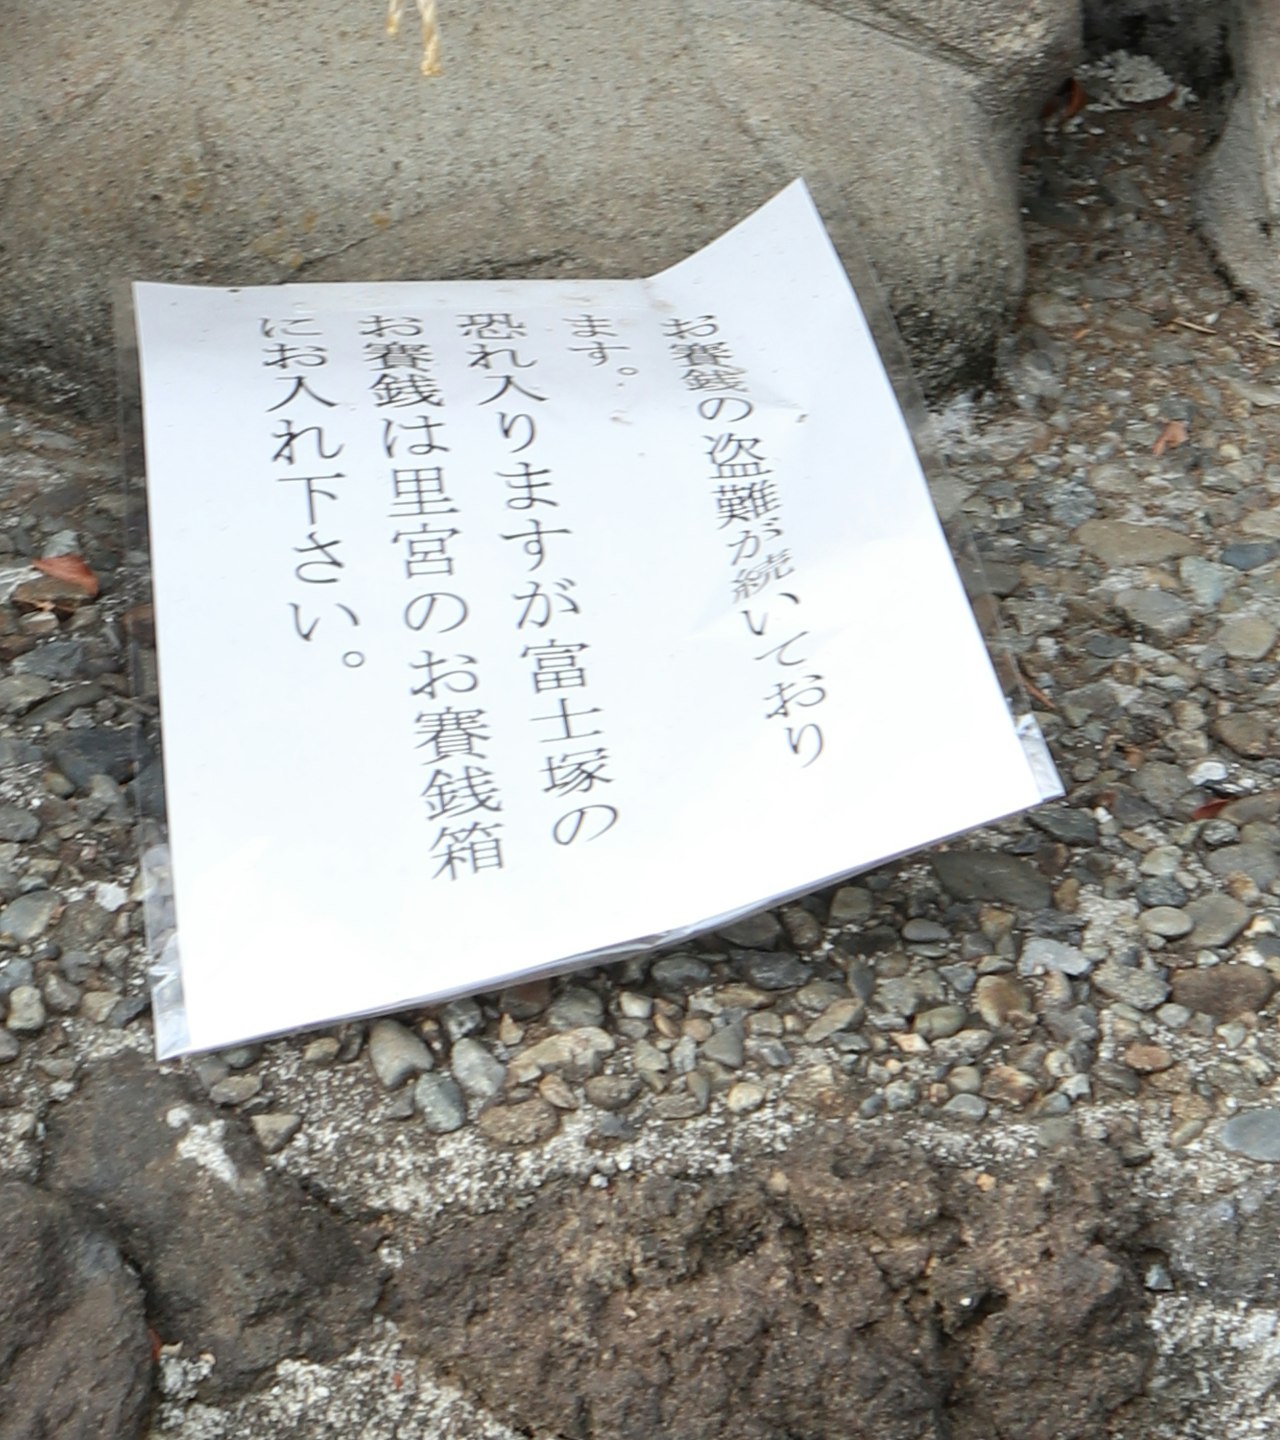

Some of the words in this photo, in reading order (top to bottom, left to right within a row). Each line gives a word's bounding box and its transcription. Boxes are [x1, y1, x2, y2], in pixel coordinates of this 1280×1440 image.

[258, 316, 366, 670] にお入れ下さい。
[561, 313, 639, 378] ます。
[662, 313, 827, 768] お賽銭の盗難が続いており
[358, 313, 505, 882] お賽銭は里宮のお賽銭箱
[456, 311, 621, 848] 恐れ入りますが富士塚の
